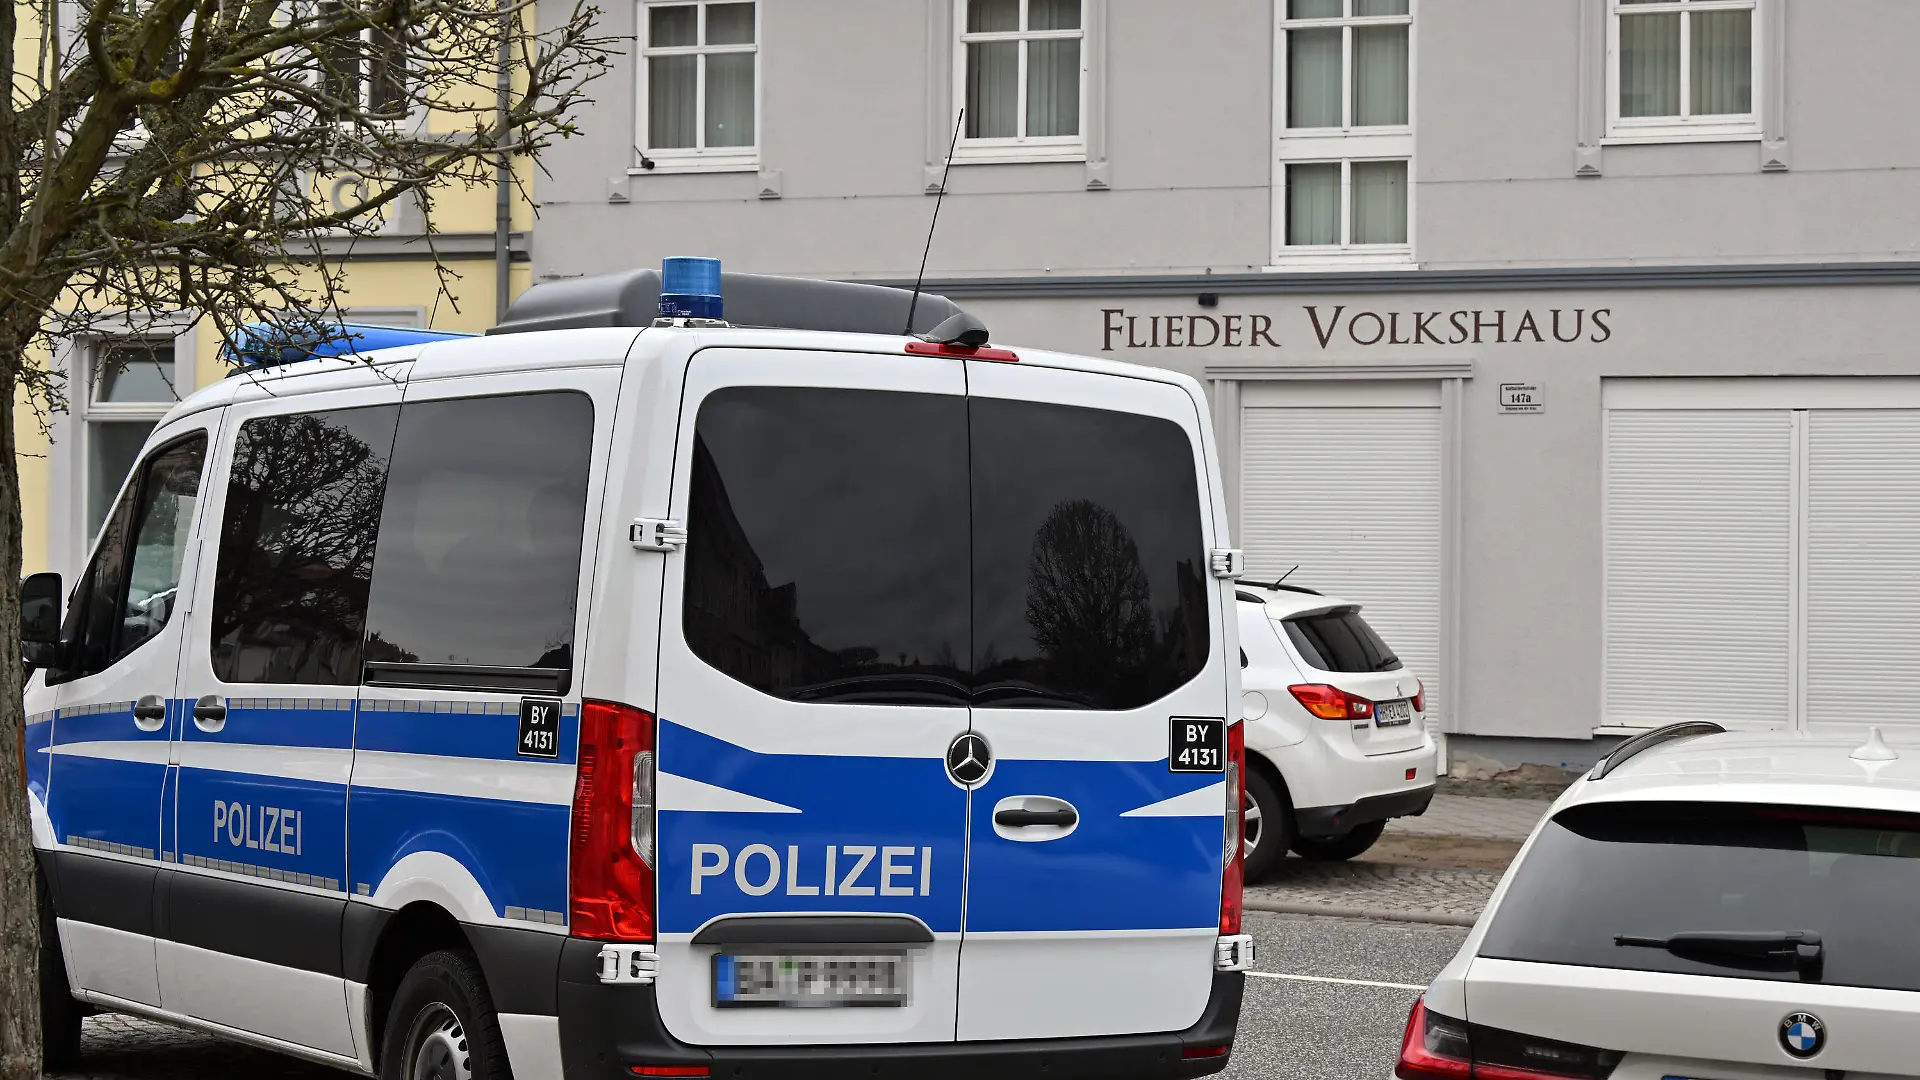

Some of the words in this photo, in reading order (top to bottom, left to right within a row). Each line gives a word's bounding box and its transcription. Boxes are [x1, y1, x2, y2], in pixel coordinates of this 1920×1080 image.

[1100, 308, 1282, 351] FLIEDER
[1302, 305, 1612, 350] VOLKSHAUS
[1511, 393, 1532, 403] 147a
[531, 705, 549, 725] BY
[523, 730, 553, 750] 4131
[1186, 724, 1209, 743] BY
[1178, 748, 1218, 766] 4131
[213, 799, 302, 856] POLIZEI
[690, 843, 932, 897] POLIZEI
[1783, 1014, 1821, 1030] BMW
